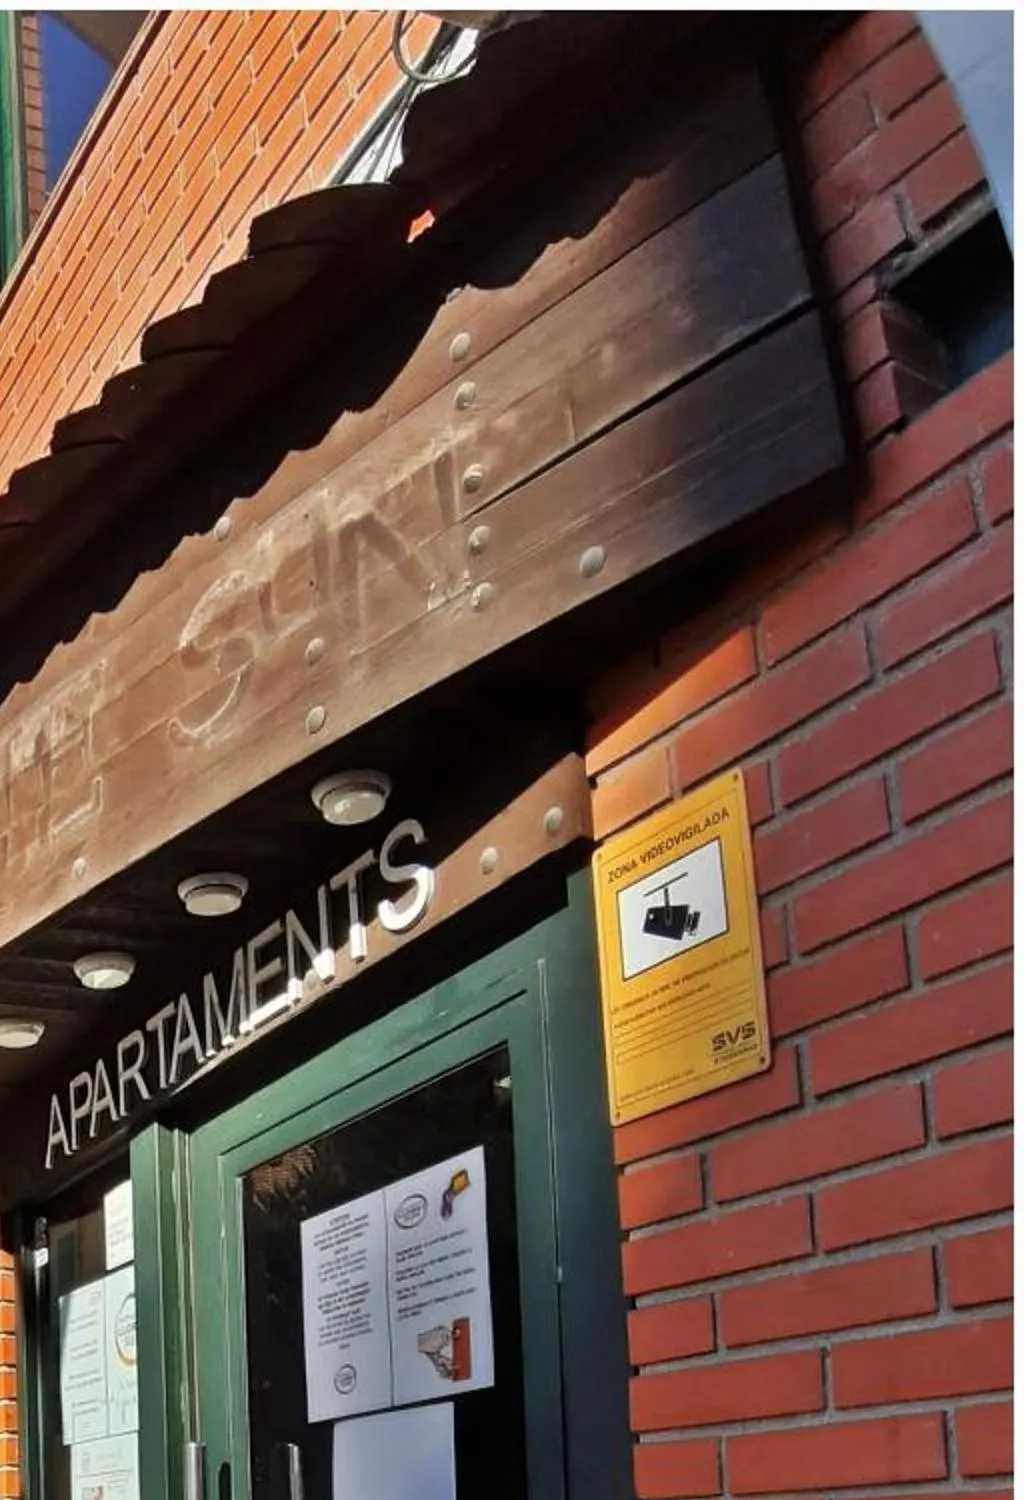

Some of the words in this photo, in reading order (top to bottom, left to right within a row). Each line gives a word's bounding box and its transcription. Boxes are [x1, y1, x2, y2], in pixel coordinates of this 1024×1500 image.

[607, 858, 638, 884] ZONA
[640, 807, 730, 866] VIDEOVIGILADA
[45, 818, 436, 1169] APARTAMENTS
[711, 1020, 757, 1051] SVS
